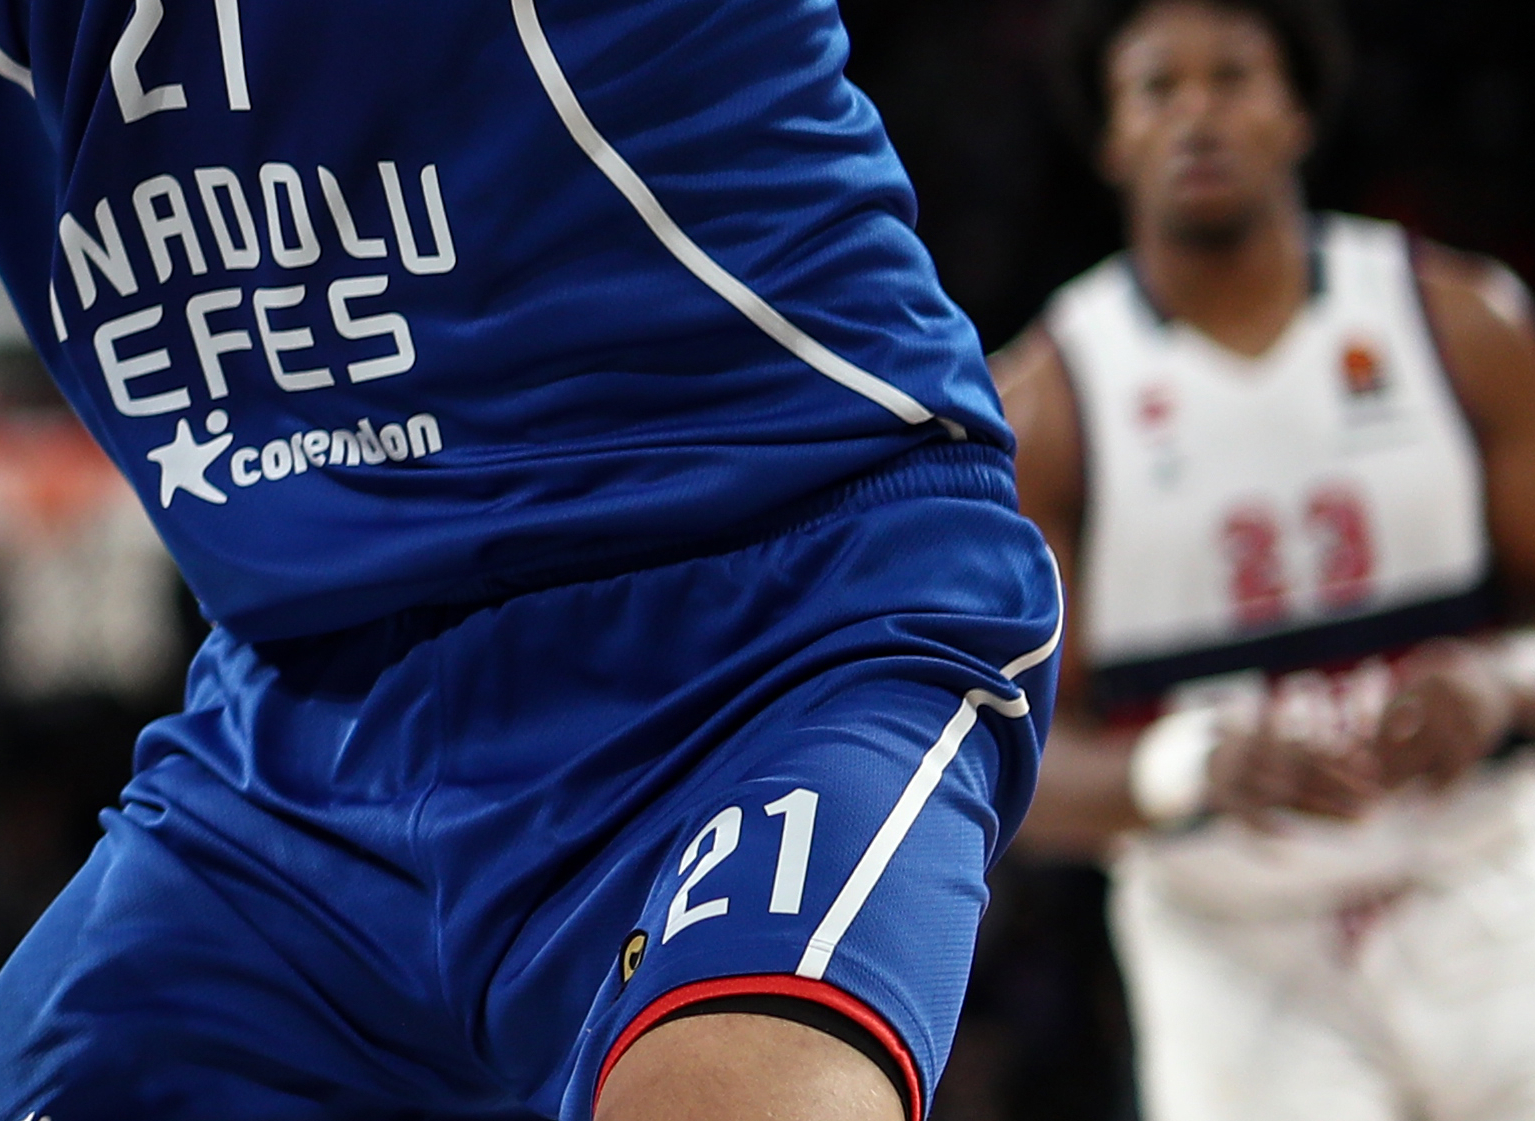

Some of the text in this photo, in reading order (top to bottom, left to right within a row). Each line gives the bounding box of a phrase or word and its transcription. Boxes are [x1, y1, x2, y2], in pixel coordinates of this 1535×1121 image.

[50, 161, 457, 343] NADOLU
[93, 275, 417, 417] EFES
[230, 412, 443, 487] corendon
[661, 788, 819, 945] 21
